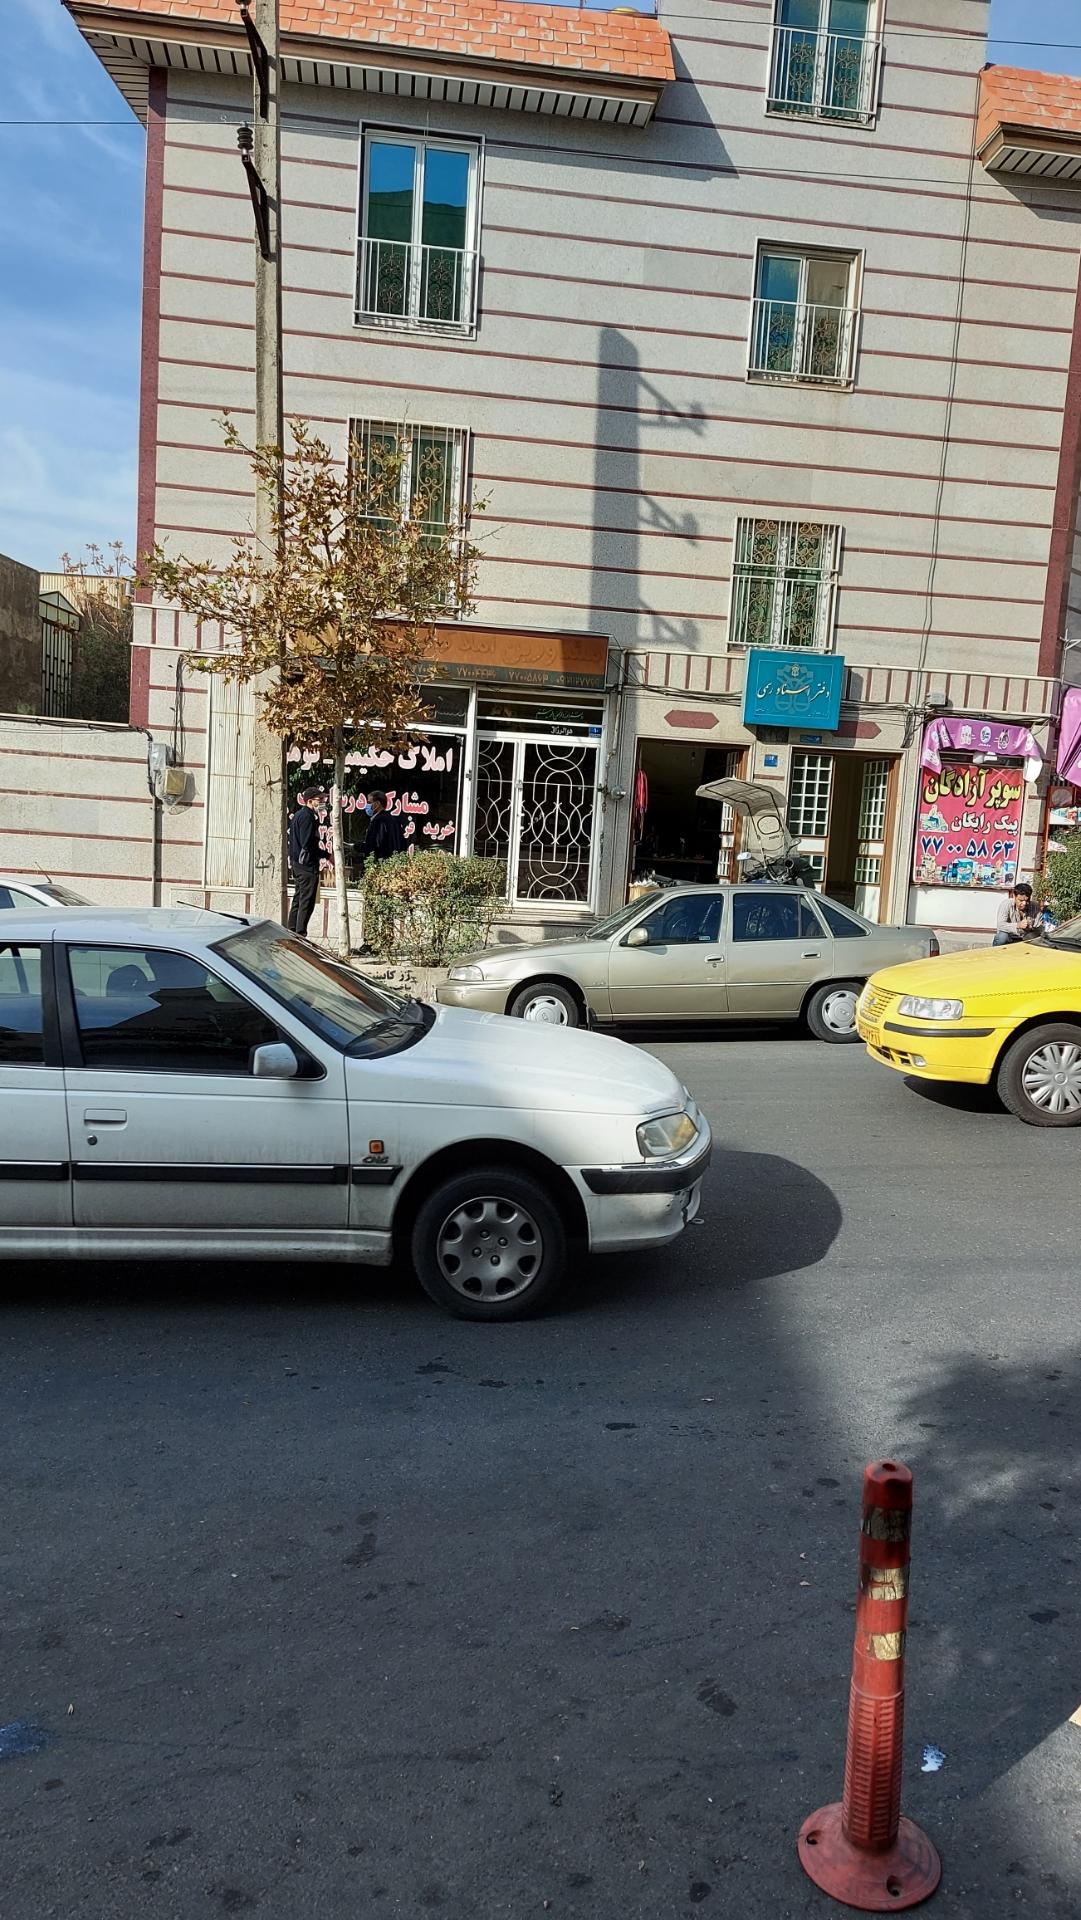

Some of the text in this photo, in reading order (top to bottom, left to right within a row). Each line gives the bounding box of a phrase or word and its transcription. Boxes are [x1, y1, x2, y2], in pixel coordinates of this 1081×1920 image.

[757, 681, 830, 704] دفتر اسناد رسمی
[344, 744, 395, 774] حکیمی
[397, 745, 453, 772] املاک
[924, 767, 1022, 809] سوپر آزادگان
[422, 820, 456, 841] خرید
[951, 811, 1019, 836] پیک رایگان
[362, 1155, 390, 1164] CNG
